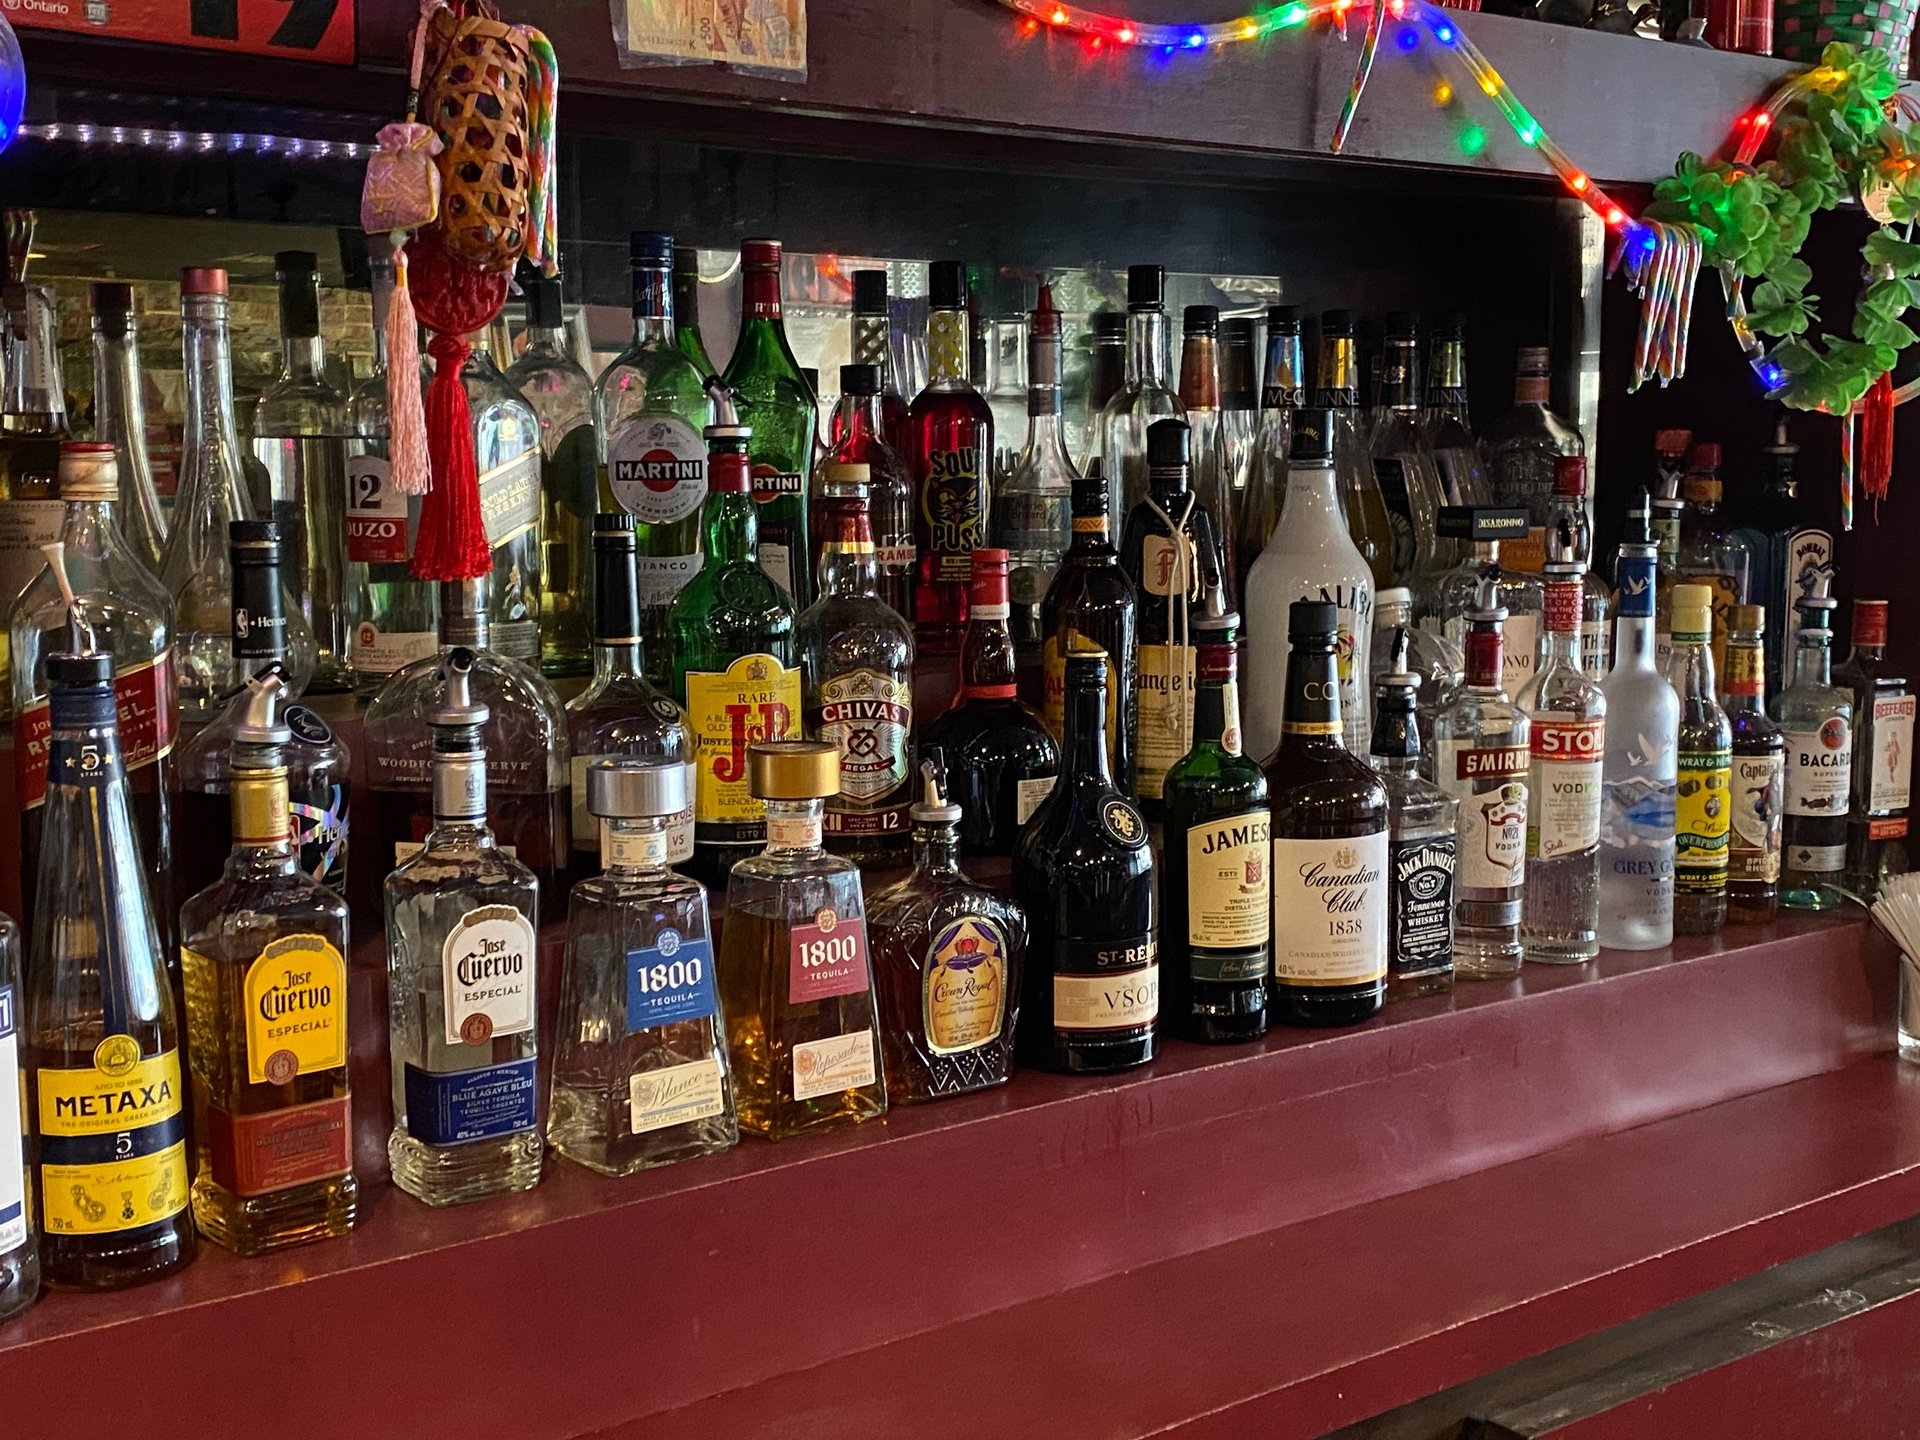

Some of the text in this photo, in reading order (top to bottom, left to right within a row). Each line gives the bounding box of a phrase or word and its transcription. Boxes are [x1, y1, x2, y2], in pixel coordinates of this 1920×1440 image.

[23, 0, 69, 14] Ontario
[618, 462, 700, 479] MARTINI
[931, 448, 976, 476] SOU
[753, 476, 799, 490] RTINI
[1477, 518, 1524, 529] DISARONNO
[931, 522, 985, 551] PUSS
[1300, 585, 1371, 624] ALIB
[737, 692, 777, 703] RARE
[821, 702, 901, 721] CHIVAS
[1875, 701, 1914, 720] BEEFEATER
[707, 723, 727, 732] OLD
[27, 738, 51, 757] RE
[81, 745, 100, 771] 5
[377, 757, 434, 769] WOODFO
[1679, 757, 1705, 767] WRAY
[1706, 757, 1715, 767] &
[1800, 753, 1850, 767] BACARD
[80, 770, 103, 778] STARS
[845, 763, 880, 772] REGAL
[718, 797, 758, 806] BLENDED
[882, 812, 899, 829] 12
[672, 834, 684, 846] VS
[1495, 841, 1521, 851] VODKA
[1397, 848, 1457, 882] JACK DANIEL'S
[1613, 860, 1658, 875] GREY
[1299, 862, 1380, 889] Canadian
[1321, 888, 1364, 914] Club
[1407, 900, 1446, 913] Tennessee
[1329, 919, 1363, 936] 1858
[1407, 913, 1445, 928] WHISKEY
[478, 938, 506, 958] Jose
[799, 935, 856, 969] 1800
[1288, 950, 1331, 959] CANADIAN
[457, 952, 523, 987] Cuervo
[638, 957, 702, 994] 1800
[810, 967, 849, 981] TEQUILA
[283, 970, 312, 991] Jose
[935, 974, 997, 1003] Crown Royal
[464, 985, 522, 1001] ESPECIAL
[650, 991, 694, 1007] TEQUILA
[1104, 981, 1157, 1010] VSOP
[260, 984, 331, 1022] Cuervo
[267, 1019, 330, 1039] ESPECIAL
[56, 1079, 172, 1117] METAXA
[452, 1090, 477, 1102] BLUE
[479, 1085, 509, 1098] AGAVE
[511, 1079, 533, 1091] BLEU
[643, 1073, 703, 1111] Blanco
[466, 1092, 520, 1108] SILVER TEQUILA
[460, 1105, 490, 1115] TEQUILA
[80, 1117, 120, 1127] ORIGINAL
[124, 1113, 148, 1122] GREEK
[116, 1131, 132, 1154] 5
[115, 1152, 134, 1161] STARS
